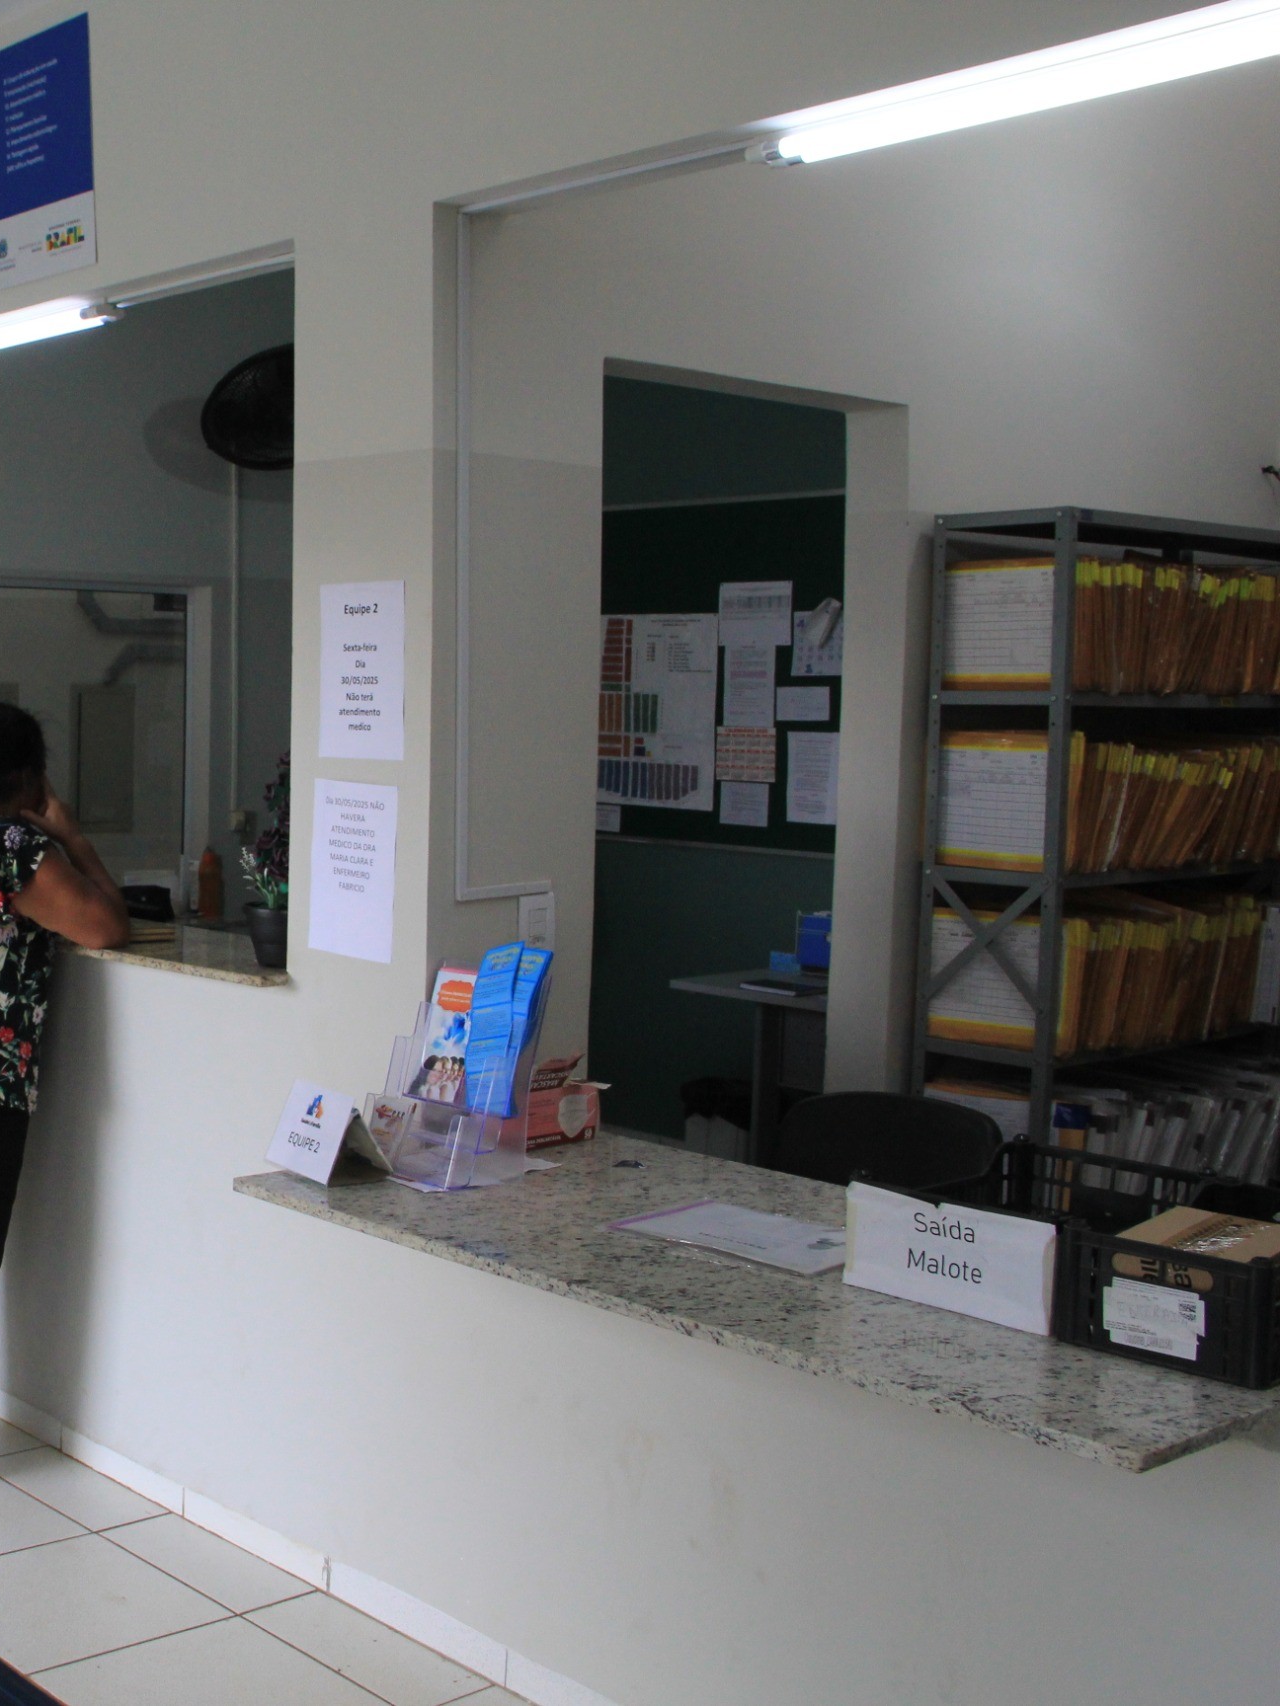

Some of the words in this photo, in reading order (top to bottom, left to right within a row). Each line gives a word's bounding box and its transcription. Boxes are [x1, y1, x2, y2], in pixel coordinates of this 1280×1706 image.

[344, 604, 371, 616] Equipe
[373, 603, 378, 613] 2
[343, 643, 377, 652] Sexta-feira
[355, 660, 366, 668] Dia
[341, 676, 379, 685] 30/05/2025
[346, 693, 360, 701] Não
[339, 708, 380, 716] atendimento
[370, 801, 384, 811] NÃO
[331, 825, 375, 838] ATENDIMENTO
[330, 853, 348, 862] MARIA
[350, 856, 368, 865] CLARA
[334, 867, 370, 880] ENFERMEIRO
[288, 1131, 315, 1151] EQUIPE
[314, 1141, 320, 1153] 2
[914, 1212, 975, 1243] Saída
[907, 1247, 982, 1284] Malote
